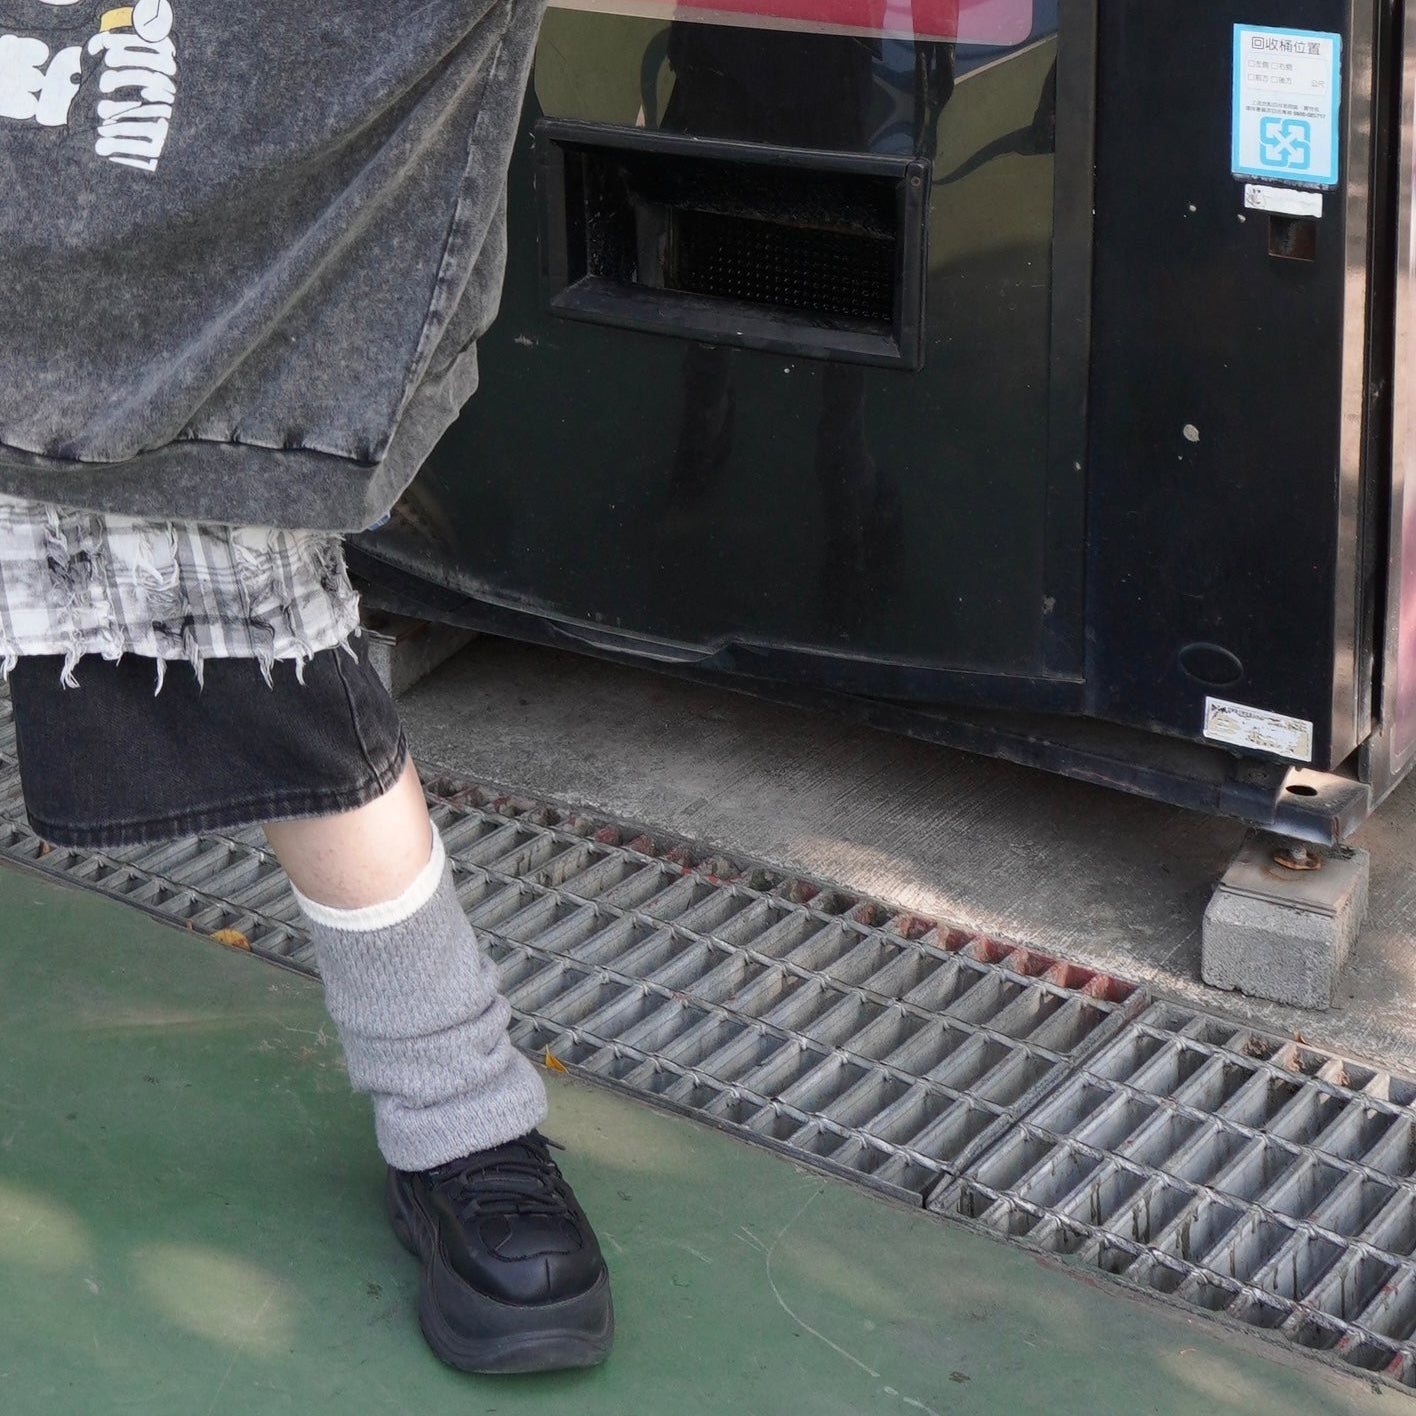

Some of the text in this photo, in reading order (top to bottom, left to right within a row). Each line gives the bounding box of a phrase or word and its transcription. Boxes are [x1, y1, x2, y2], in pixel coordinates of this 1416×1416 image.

[1251, 36, 1321, 56] 回收桶位置
